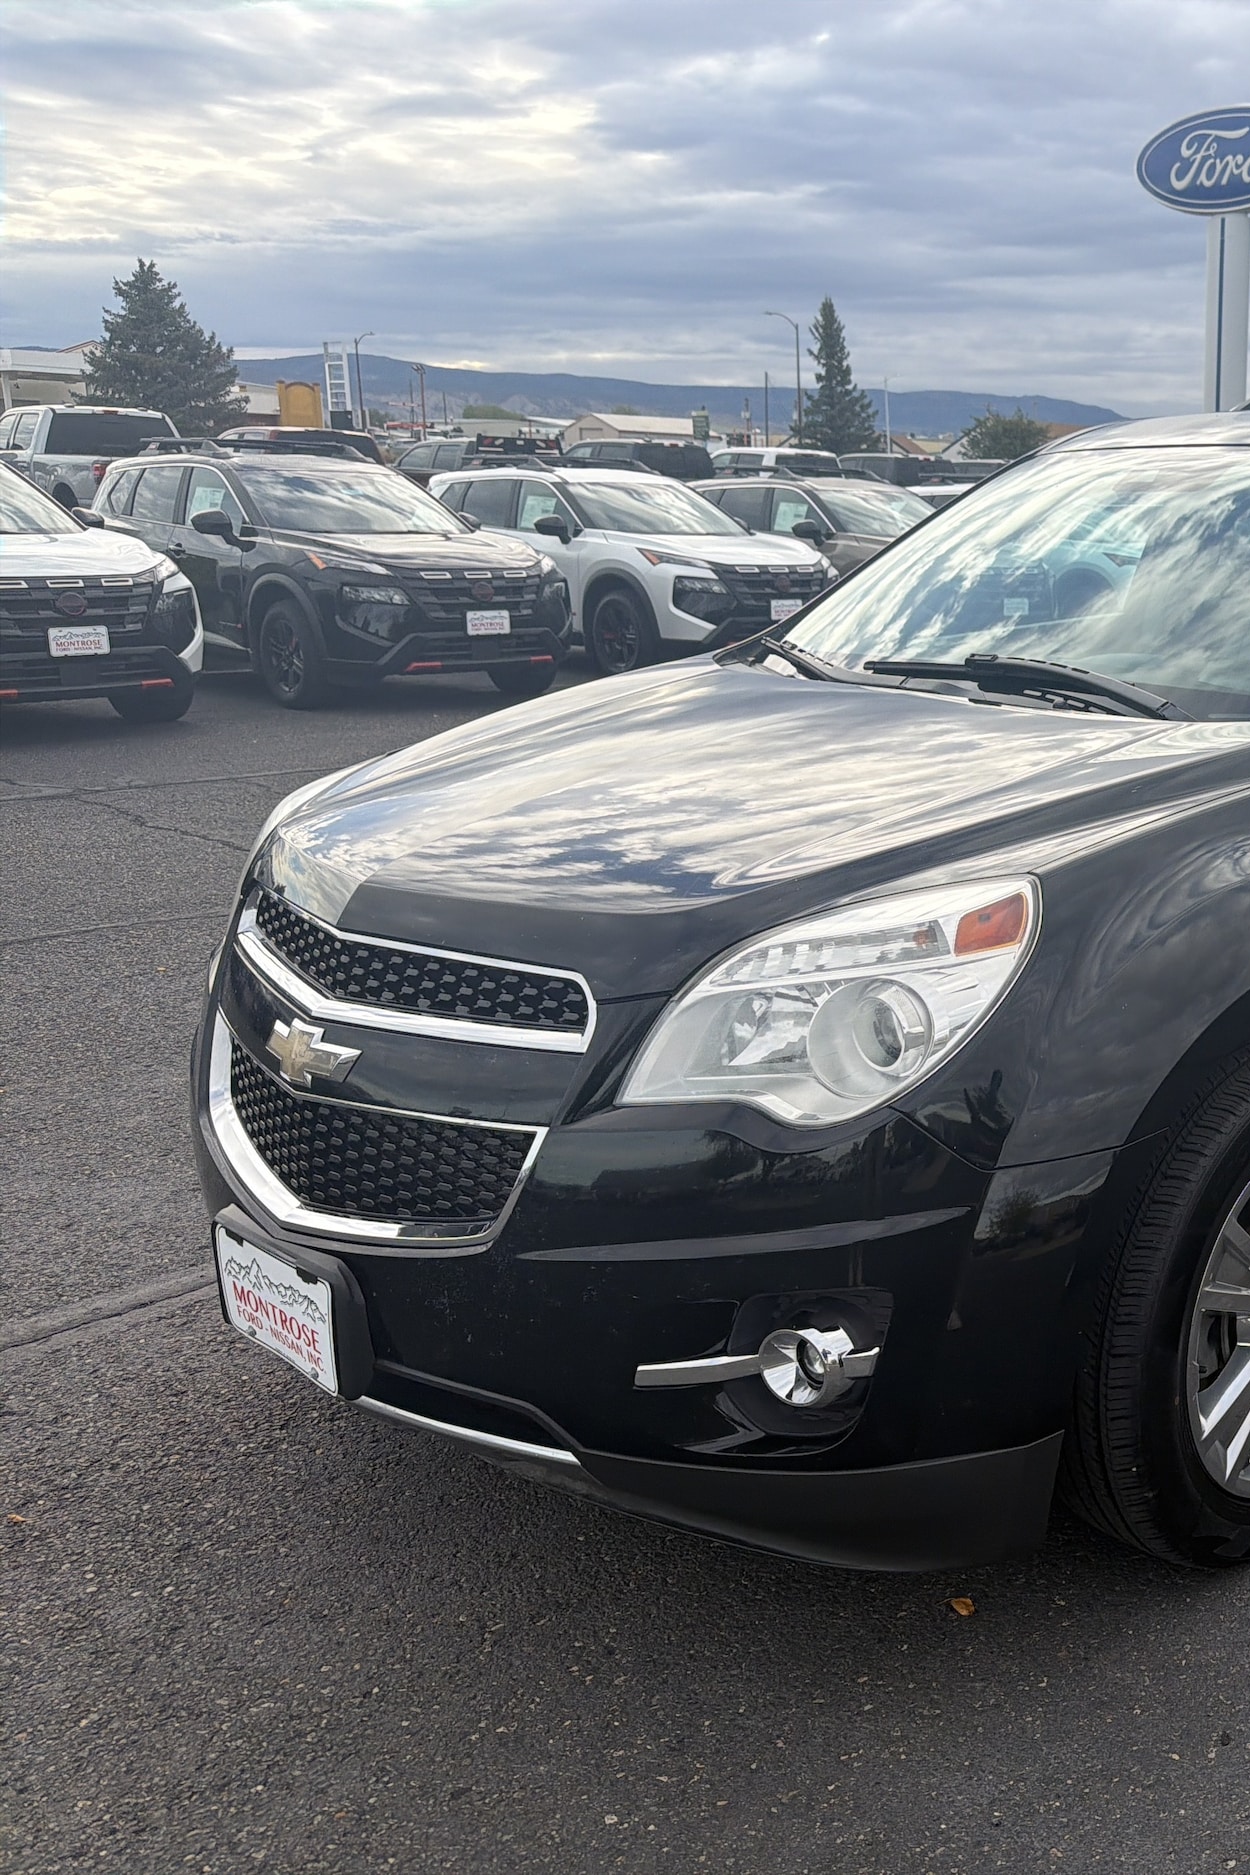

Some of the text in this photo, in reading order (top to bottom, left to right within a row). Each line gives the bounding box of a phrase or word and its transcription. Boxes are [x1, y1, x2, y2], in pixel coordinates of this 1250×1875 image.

[55, 639, 102, 648] MONTROSE
[232, 1280, 322, 1355] MONTROSE
[236, 1304, 264, 1330] FORD
